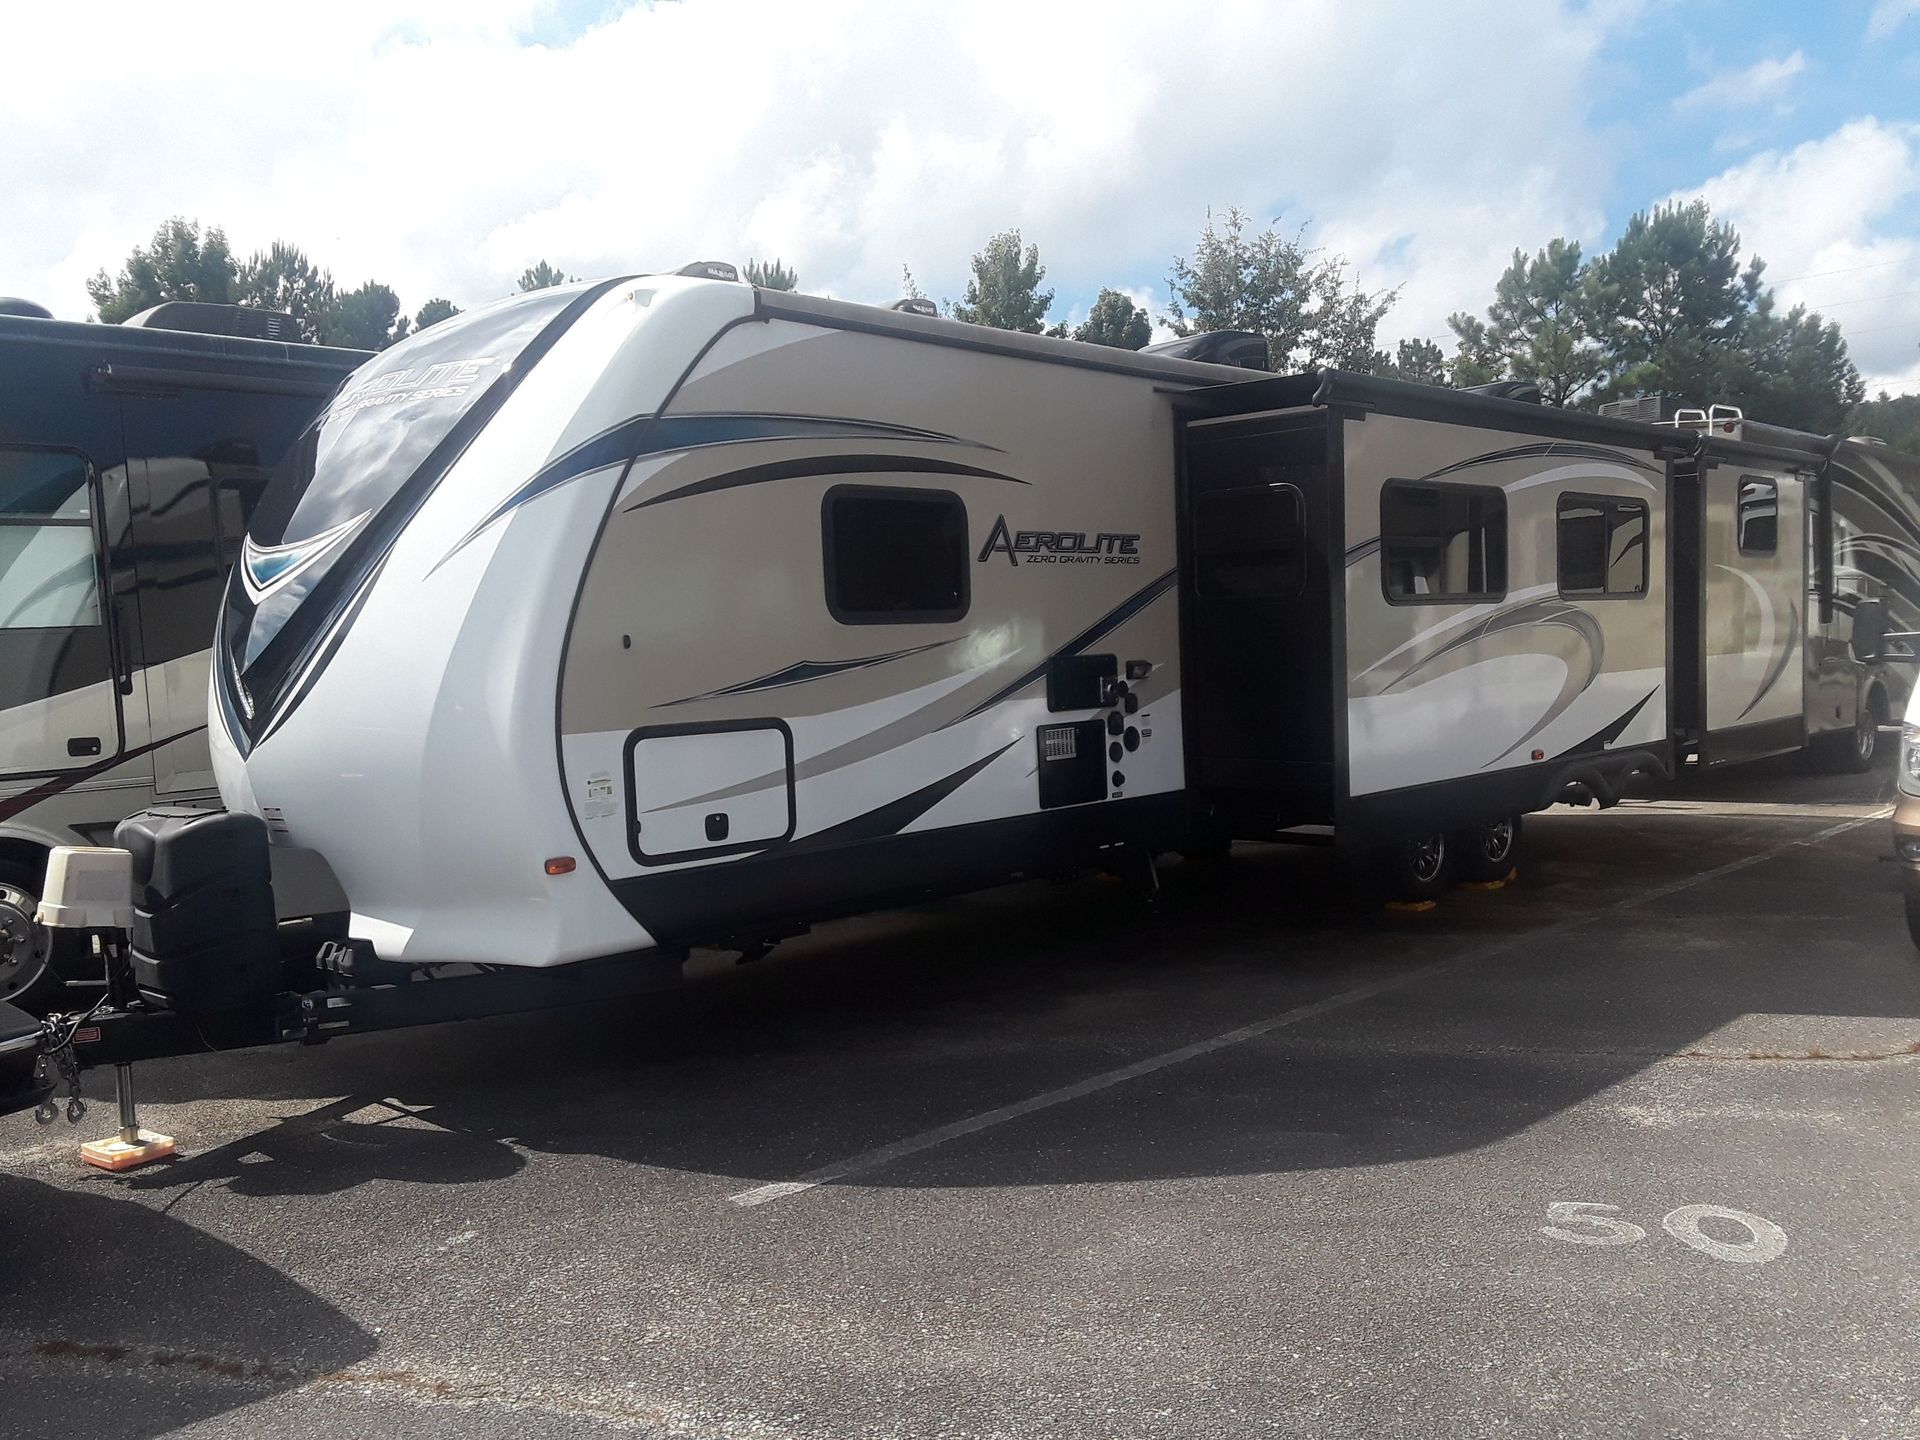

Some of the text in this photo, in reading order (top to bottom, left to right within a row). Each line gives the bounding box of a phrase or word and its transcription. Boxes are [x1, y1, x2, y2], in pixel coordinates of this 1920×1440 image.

[409, 385, 471, 401] SERIES
[977, 513, 1141, 567] AEROLITE
[1026, 555, 1140, 565] ZERO GRAVITY SERIES
[1541, 1201, 1788, 1264] 50
